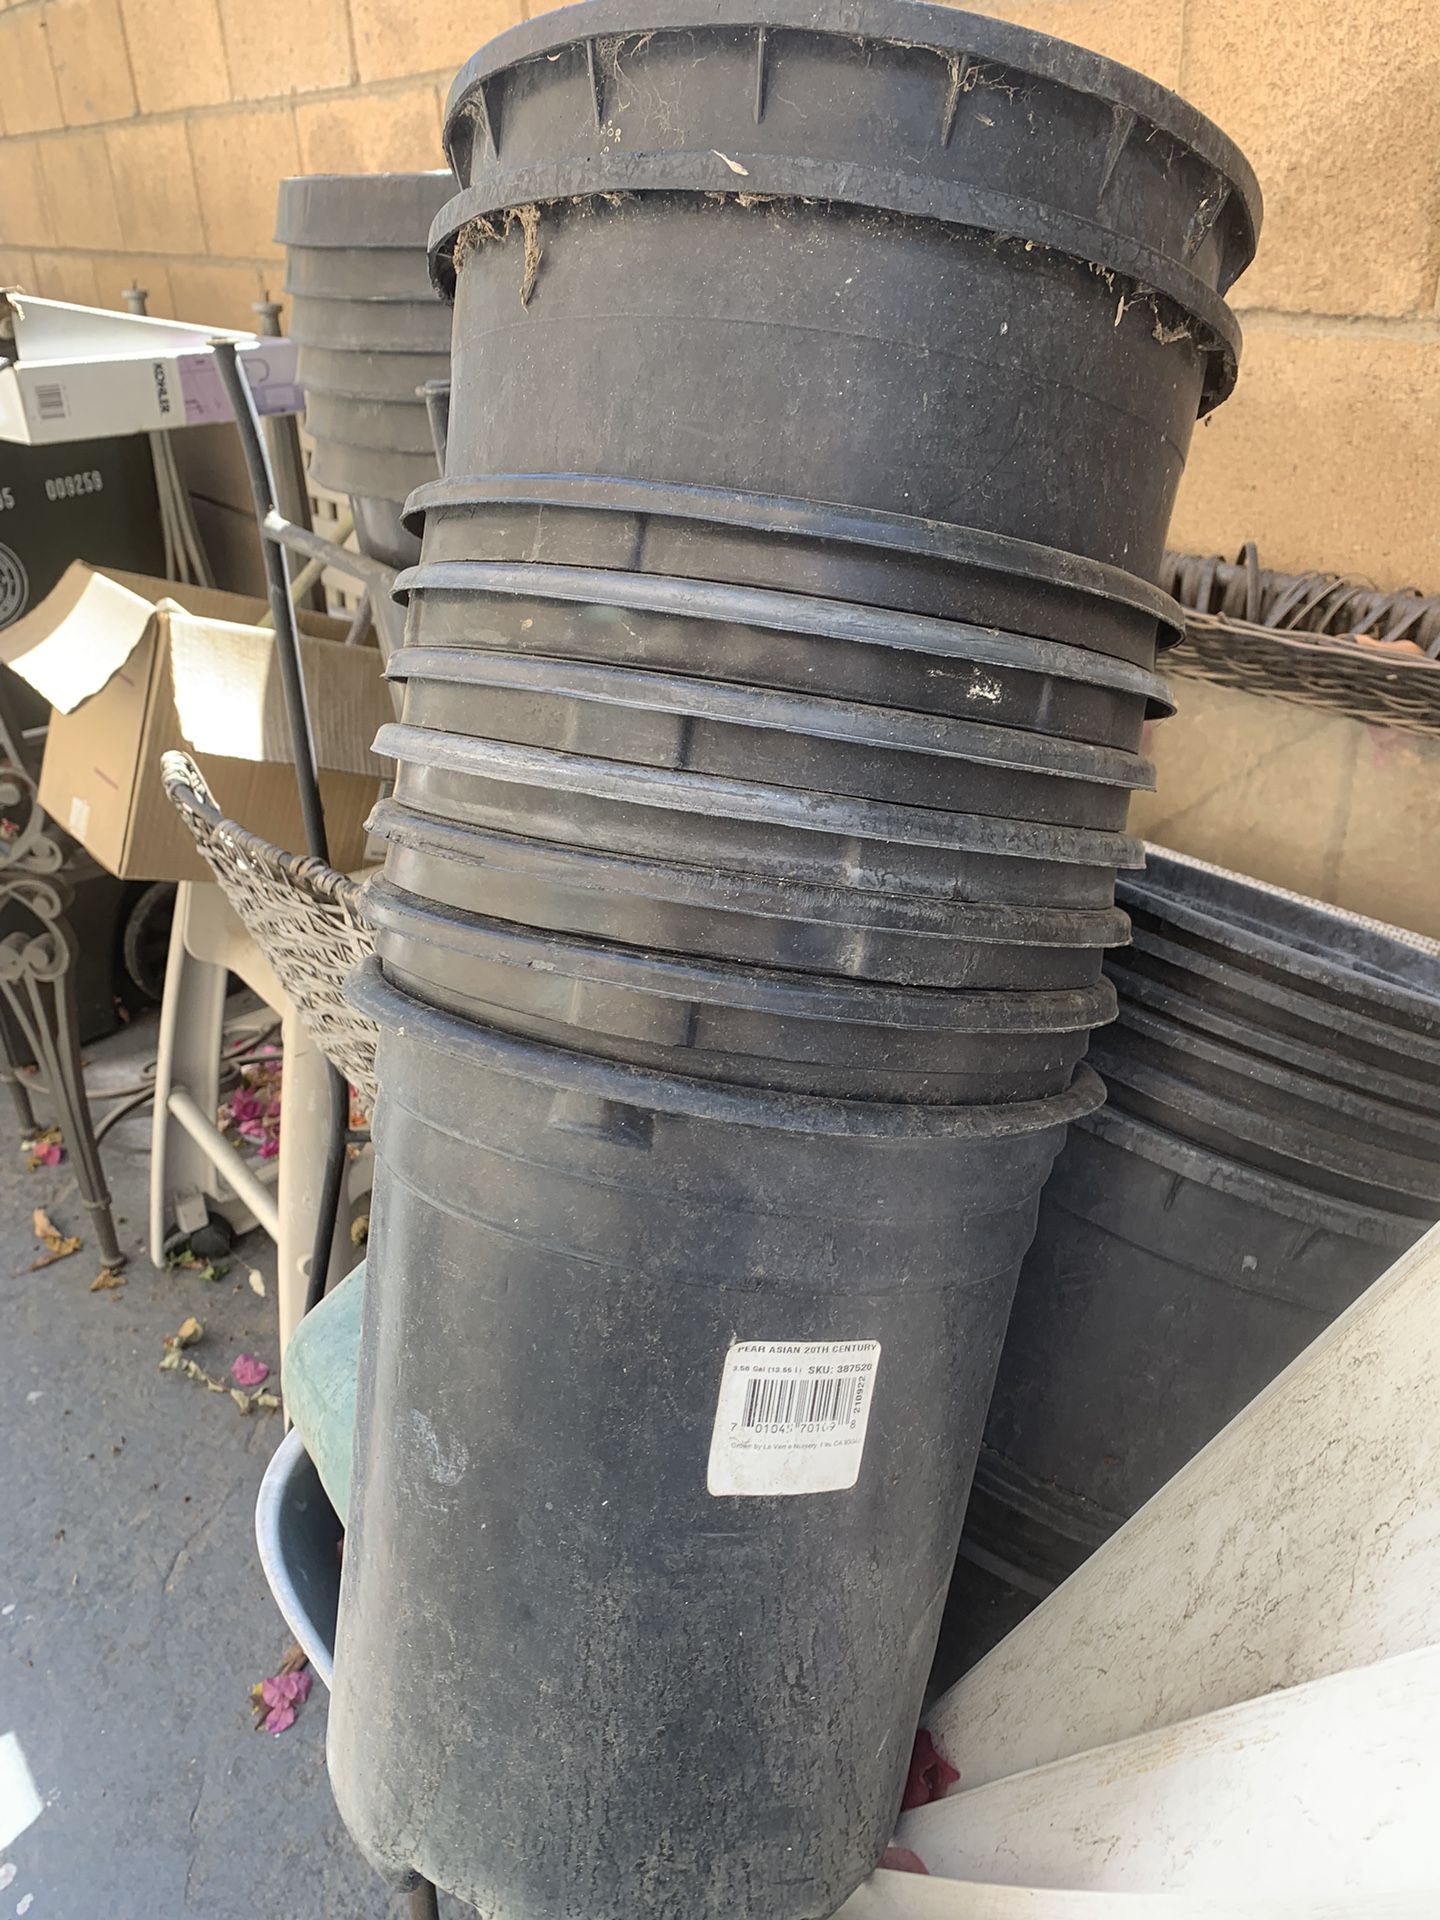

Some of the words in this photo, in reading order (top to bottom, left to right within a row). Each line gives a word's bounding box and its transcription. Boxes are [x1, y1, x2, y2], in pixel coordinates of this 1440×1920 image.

[152, 362, 170, 413] KOHLER
[737, 1345, 766, 1354] PEAR
[768, 1345, 801, 1354] ASIAN
[803, 1345, 830, 1354] 20TH
[832, 1343, 877, 1354] CENTURY
[808, 1365, 834, 1375] SKU:
[837, 1362, 873, 1374] 387520
[854, 1375, 867, 1414] 210922
[730, 1422, 738, 1431] 7
